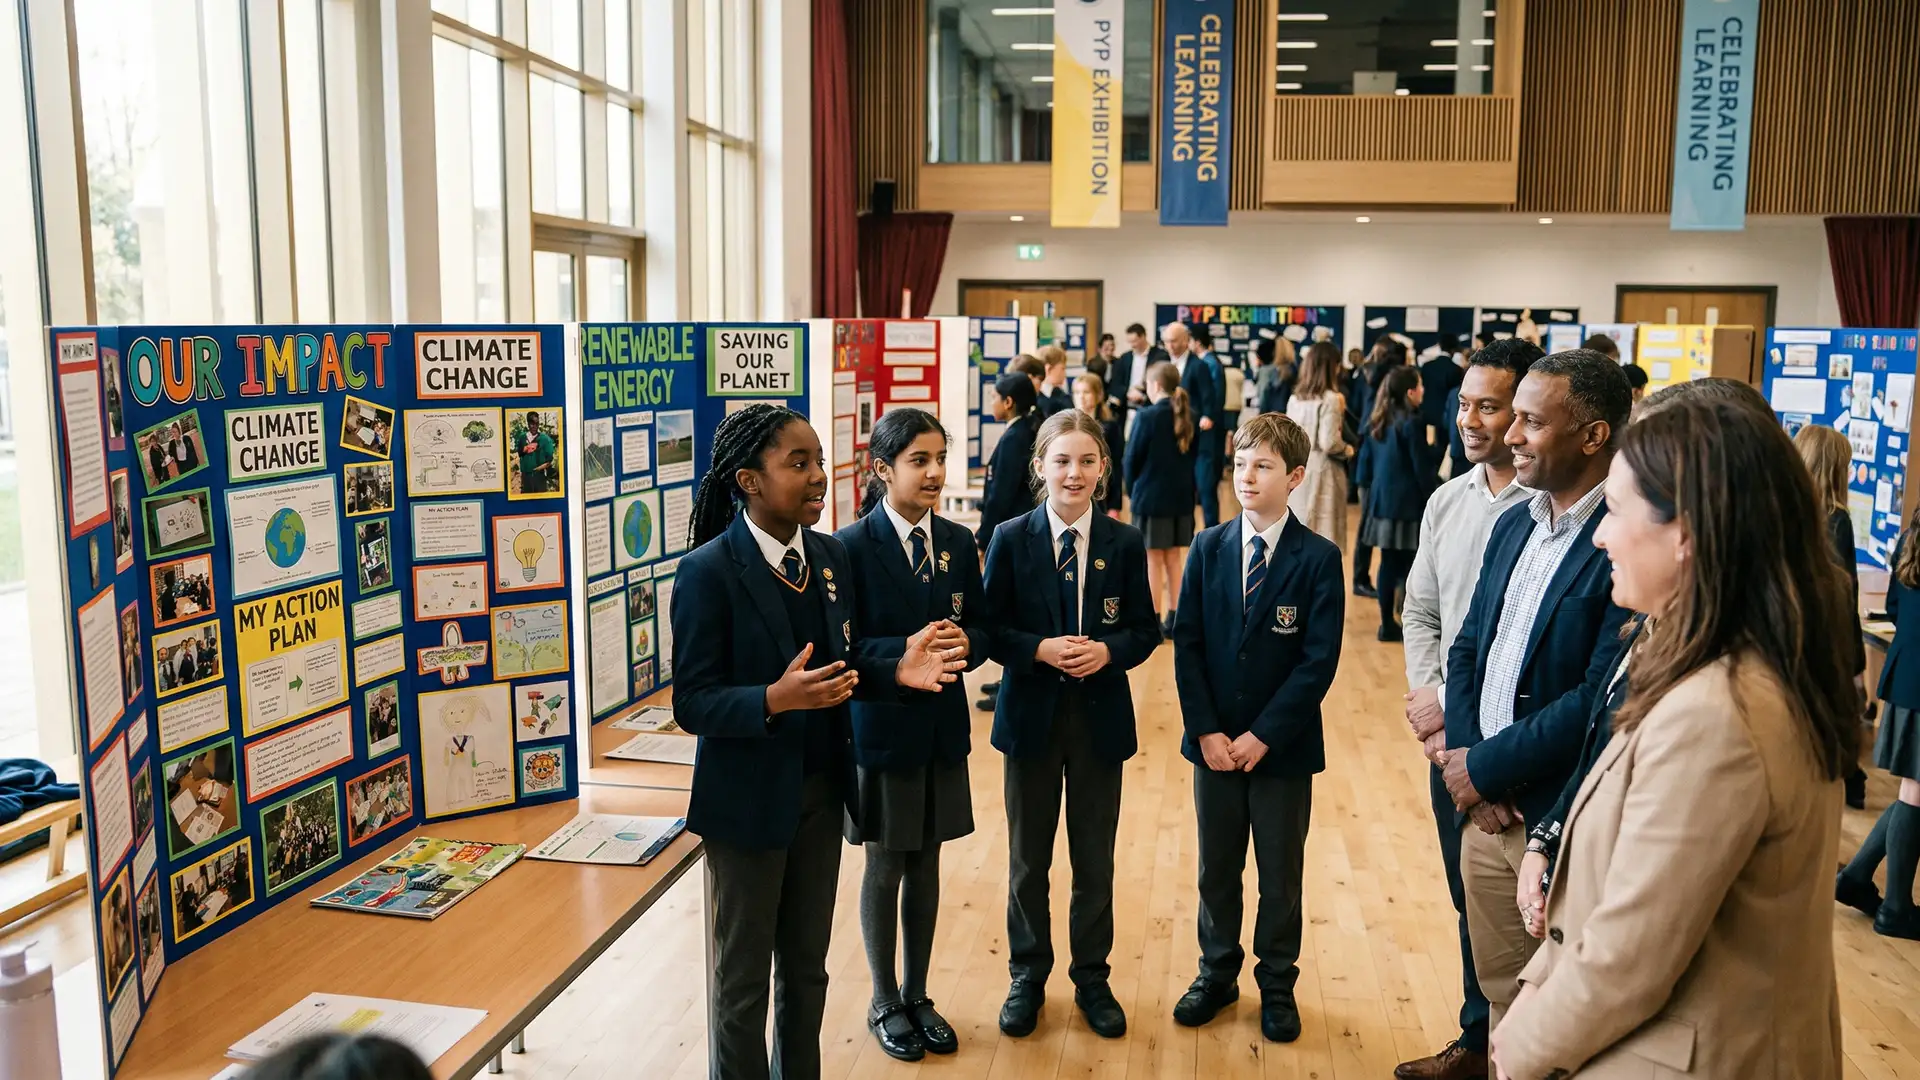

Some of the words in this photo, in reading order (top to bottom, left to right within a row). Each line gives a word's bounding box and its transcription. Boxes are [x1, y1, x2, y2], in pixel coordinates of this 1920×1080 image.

[1093, 20, 1111, 62] PYP
[1172, 34, 1195, 162] LEARNING
[1197, 14, 1222, 182] CELEBRATING
[1688, 28, 1716, 162] LEARNING
[1713, 16, 1743, 191] CELEBRATING
[1091, 69, 1110, 195] EXHIBITION
[1177, 305, 1216, 324] PYP
[1219, 306, 1318, 324] EXHIBITION
[422, 339, 532, 362] CLIMATE
[720, 332, 789, 349] SAVING
[127, 335, 226, 407] OUR
[236, 332, 392, 397] IMPACT
[426, 366, 529, 390] CHANGE
[736, 353, 774, 369] OUR
[594, 369, 675, 410] ENERGY
[720, 372, 790, 389] PLANET
[231, 410, 319, 442] CLIMATE
[239, 440, 320, 473] CHANGE
[239, 602, 268, 633] MY
[273, 585, 340, 623] ACTION
[269, 617, 317, 652] PLAN
